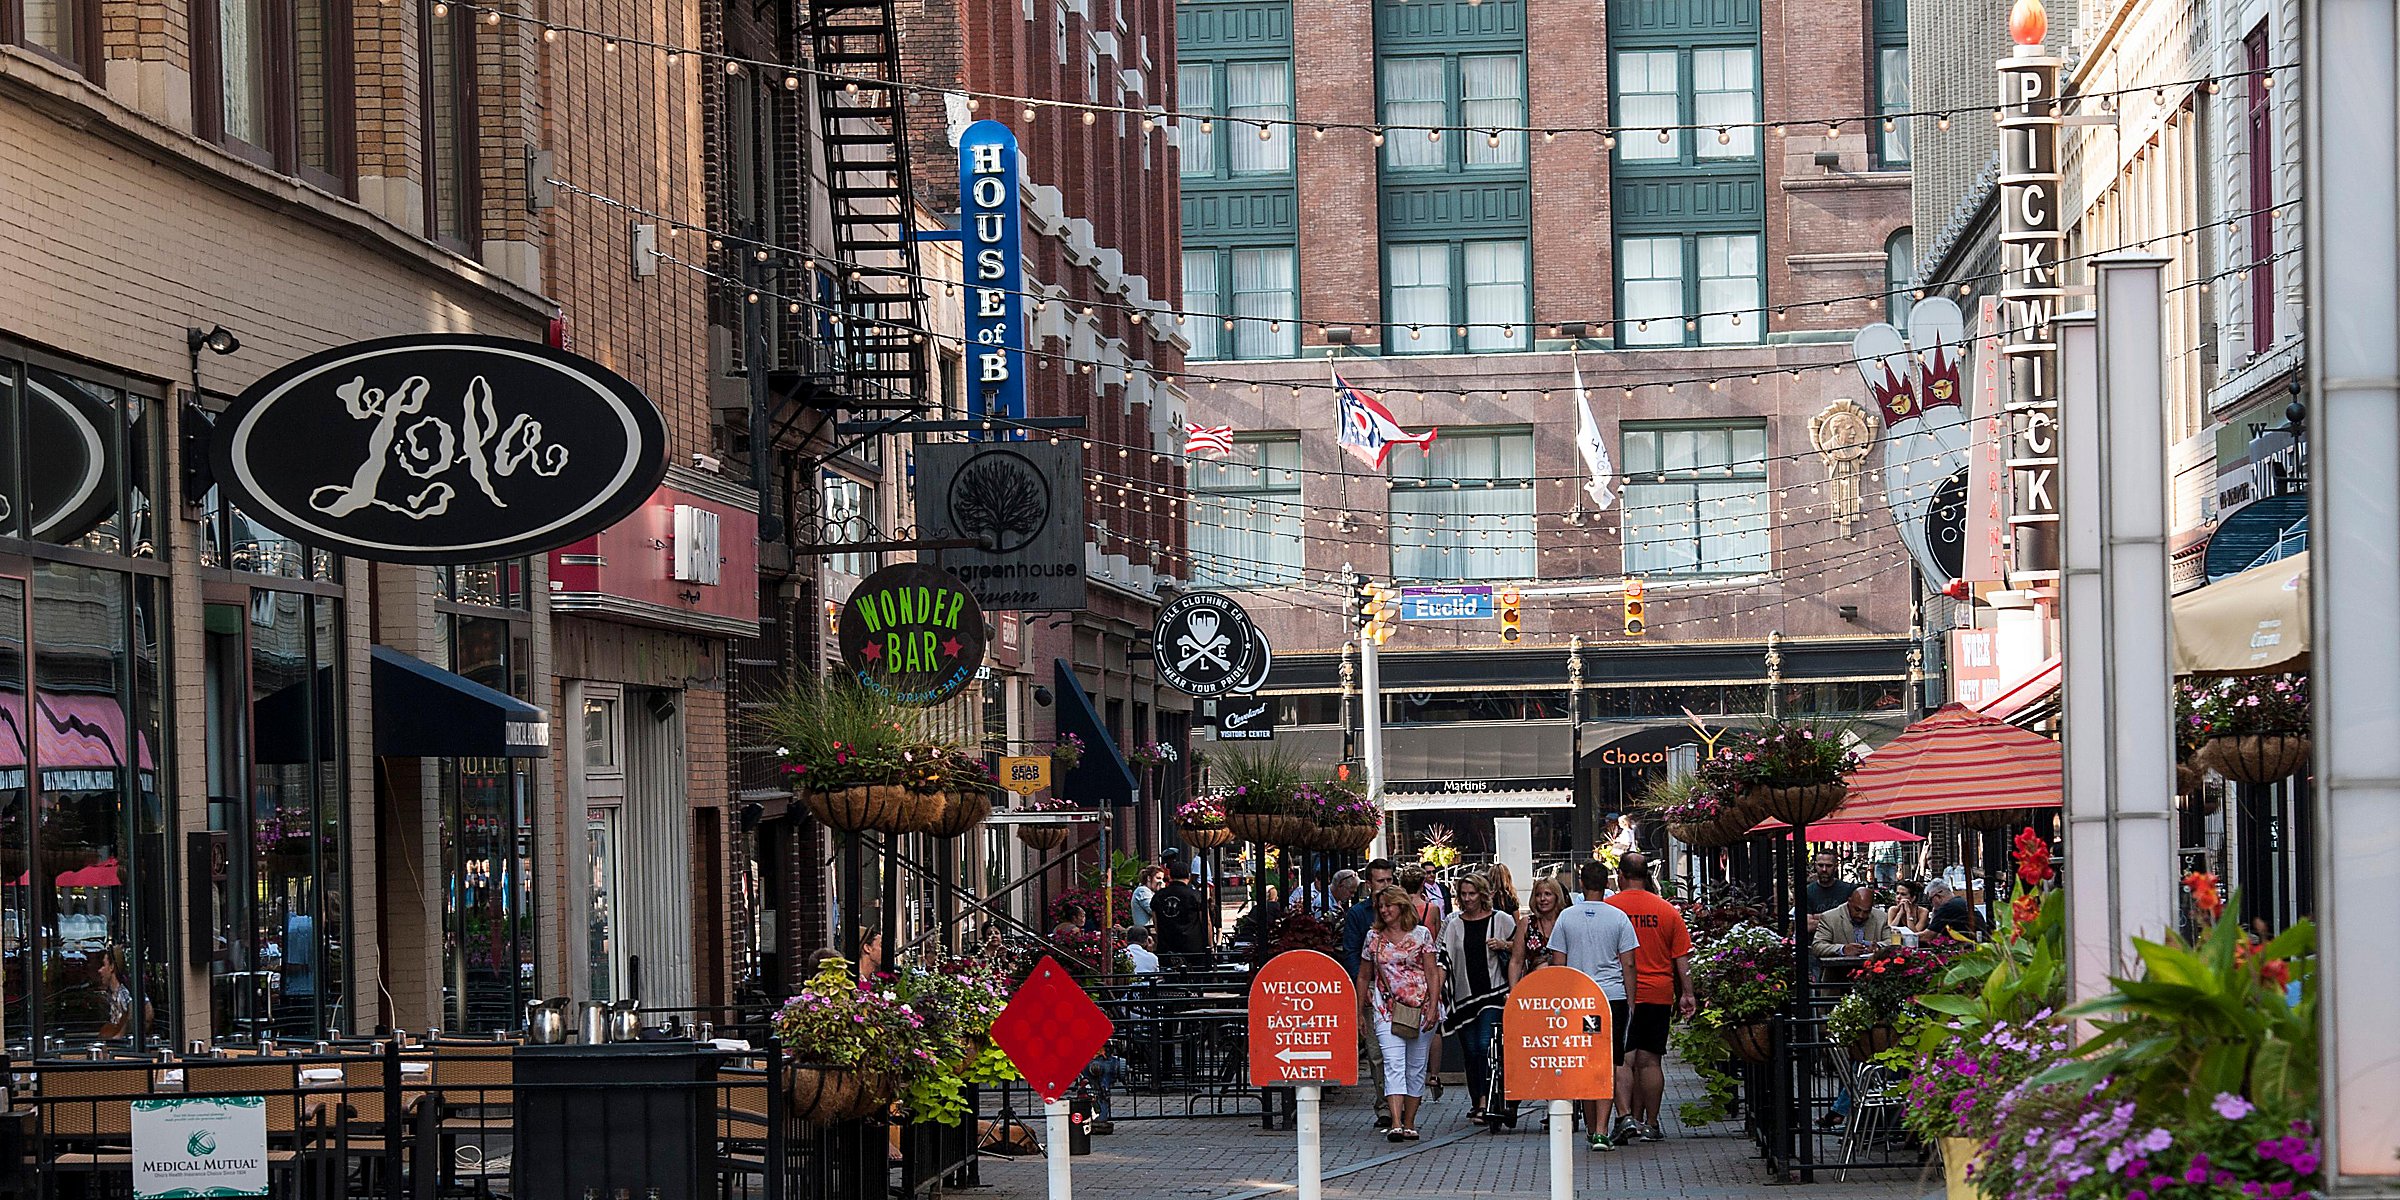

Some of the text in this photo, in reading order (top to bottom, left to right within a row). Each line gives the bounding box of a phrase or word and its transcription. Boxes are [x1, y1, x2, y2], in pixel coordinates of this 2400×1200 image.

[971, 144, 1006, 317] HOUSE
[2020, 72, 2053, 511] PICKWICK
[978, 323, 1006, 344] of
[2248, 423, 2267, 438] W
[1984, 303, 1999, 574] RESTAURANT
[309, 375, 568, 518] Lola
[856, 586, 964, 633] WONDER
[1163, 596, 1243, 624] CLE CLOTHING CO.
[1416, 598, 1477, 616] Euclid
[887, 631, 938, 674] BAR
[858, 671, 889, 697] FOOD
[943, 665, 968, 693] JAZZ
[1164, 665, 1245, 693] WEAR YOUR PRIDE
[1225, 702, 1266, 729] Cleveland
[1220, 730, 1270, 738] VISITORS CENTER
[1602, 746, 1700, 765] Chocol
[1011, 765, 1039, 773] GEAR
[1011, 773, 1039, 781] SHOP
[1443, 780, 1487, 791] Martinis
[1262, 981, 1342, 994] WELCOME
[1290, 998, 1314, 1011] TO
[1517, 997, 1596, 1010] WELCOME
[1267, 1015, 1338, 1028] EAST 4TH
[1546, 1016, 1568, 1029] TO
[1275, 1032, 1331, 1045] STREET
[1522, 1035, 1593, 1048] EAST 4TH
[1530, 1056, 1585, 1069] STREET
[1279, 1066, 1327, 1079] VALET
[143, 1160, 200, 1172] MEDICAL
